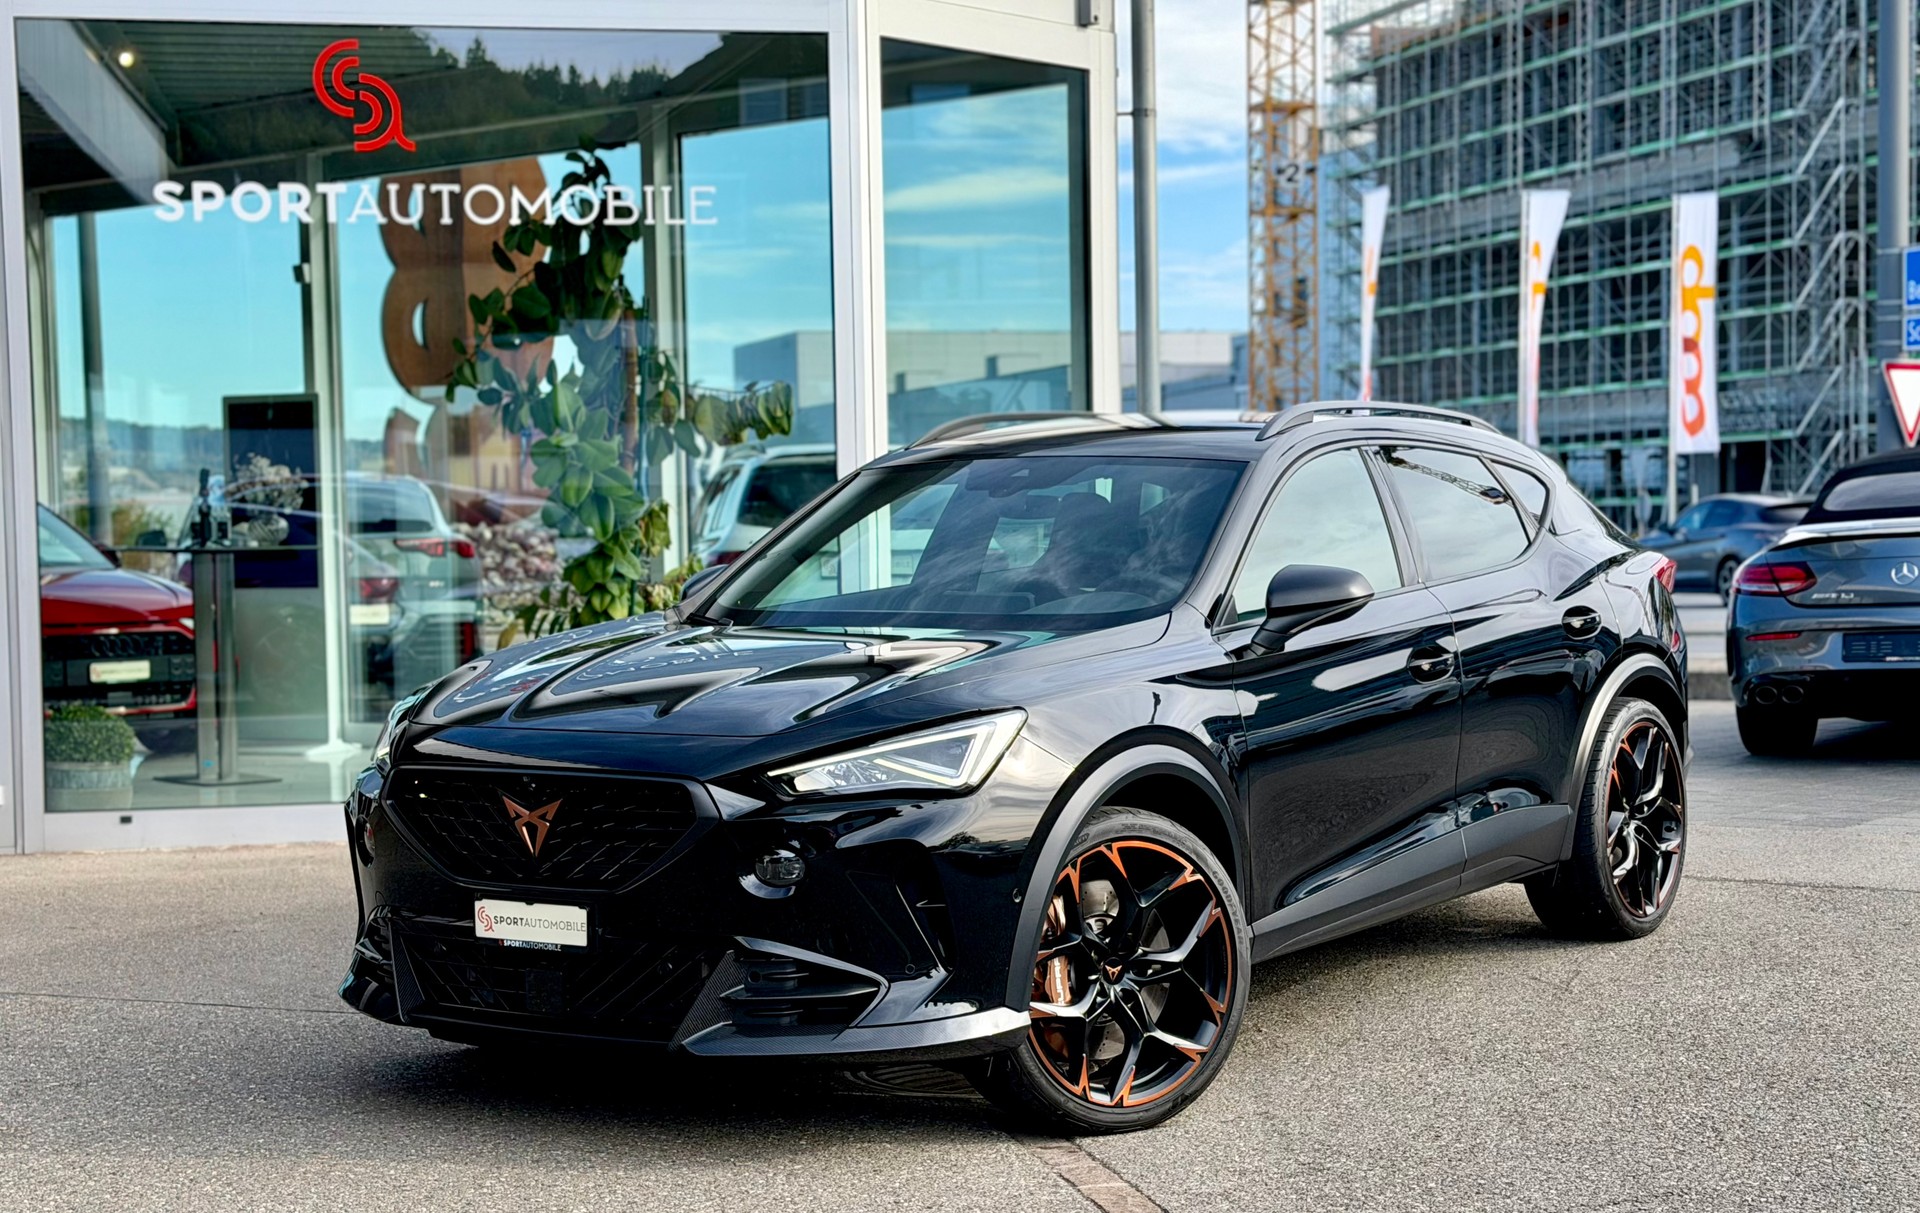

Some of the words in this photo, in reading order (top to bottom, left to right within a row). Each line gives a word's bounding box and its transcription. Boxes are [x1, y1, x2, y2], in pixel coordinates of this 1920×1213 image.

[152, 180, 718, 226] SPORTAUTOMOBILE
[494, 915, 586, 932] SPORTAUTOMOBILE
[503, 940, 561, 951] SPORTAUTOMOBILE
